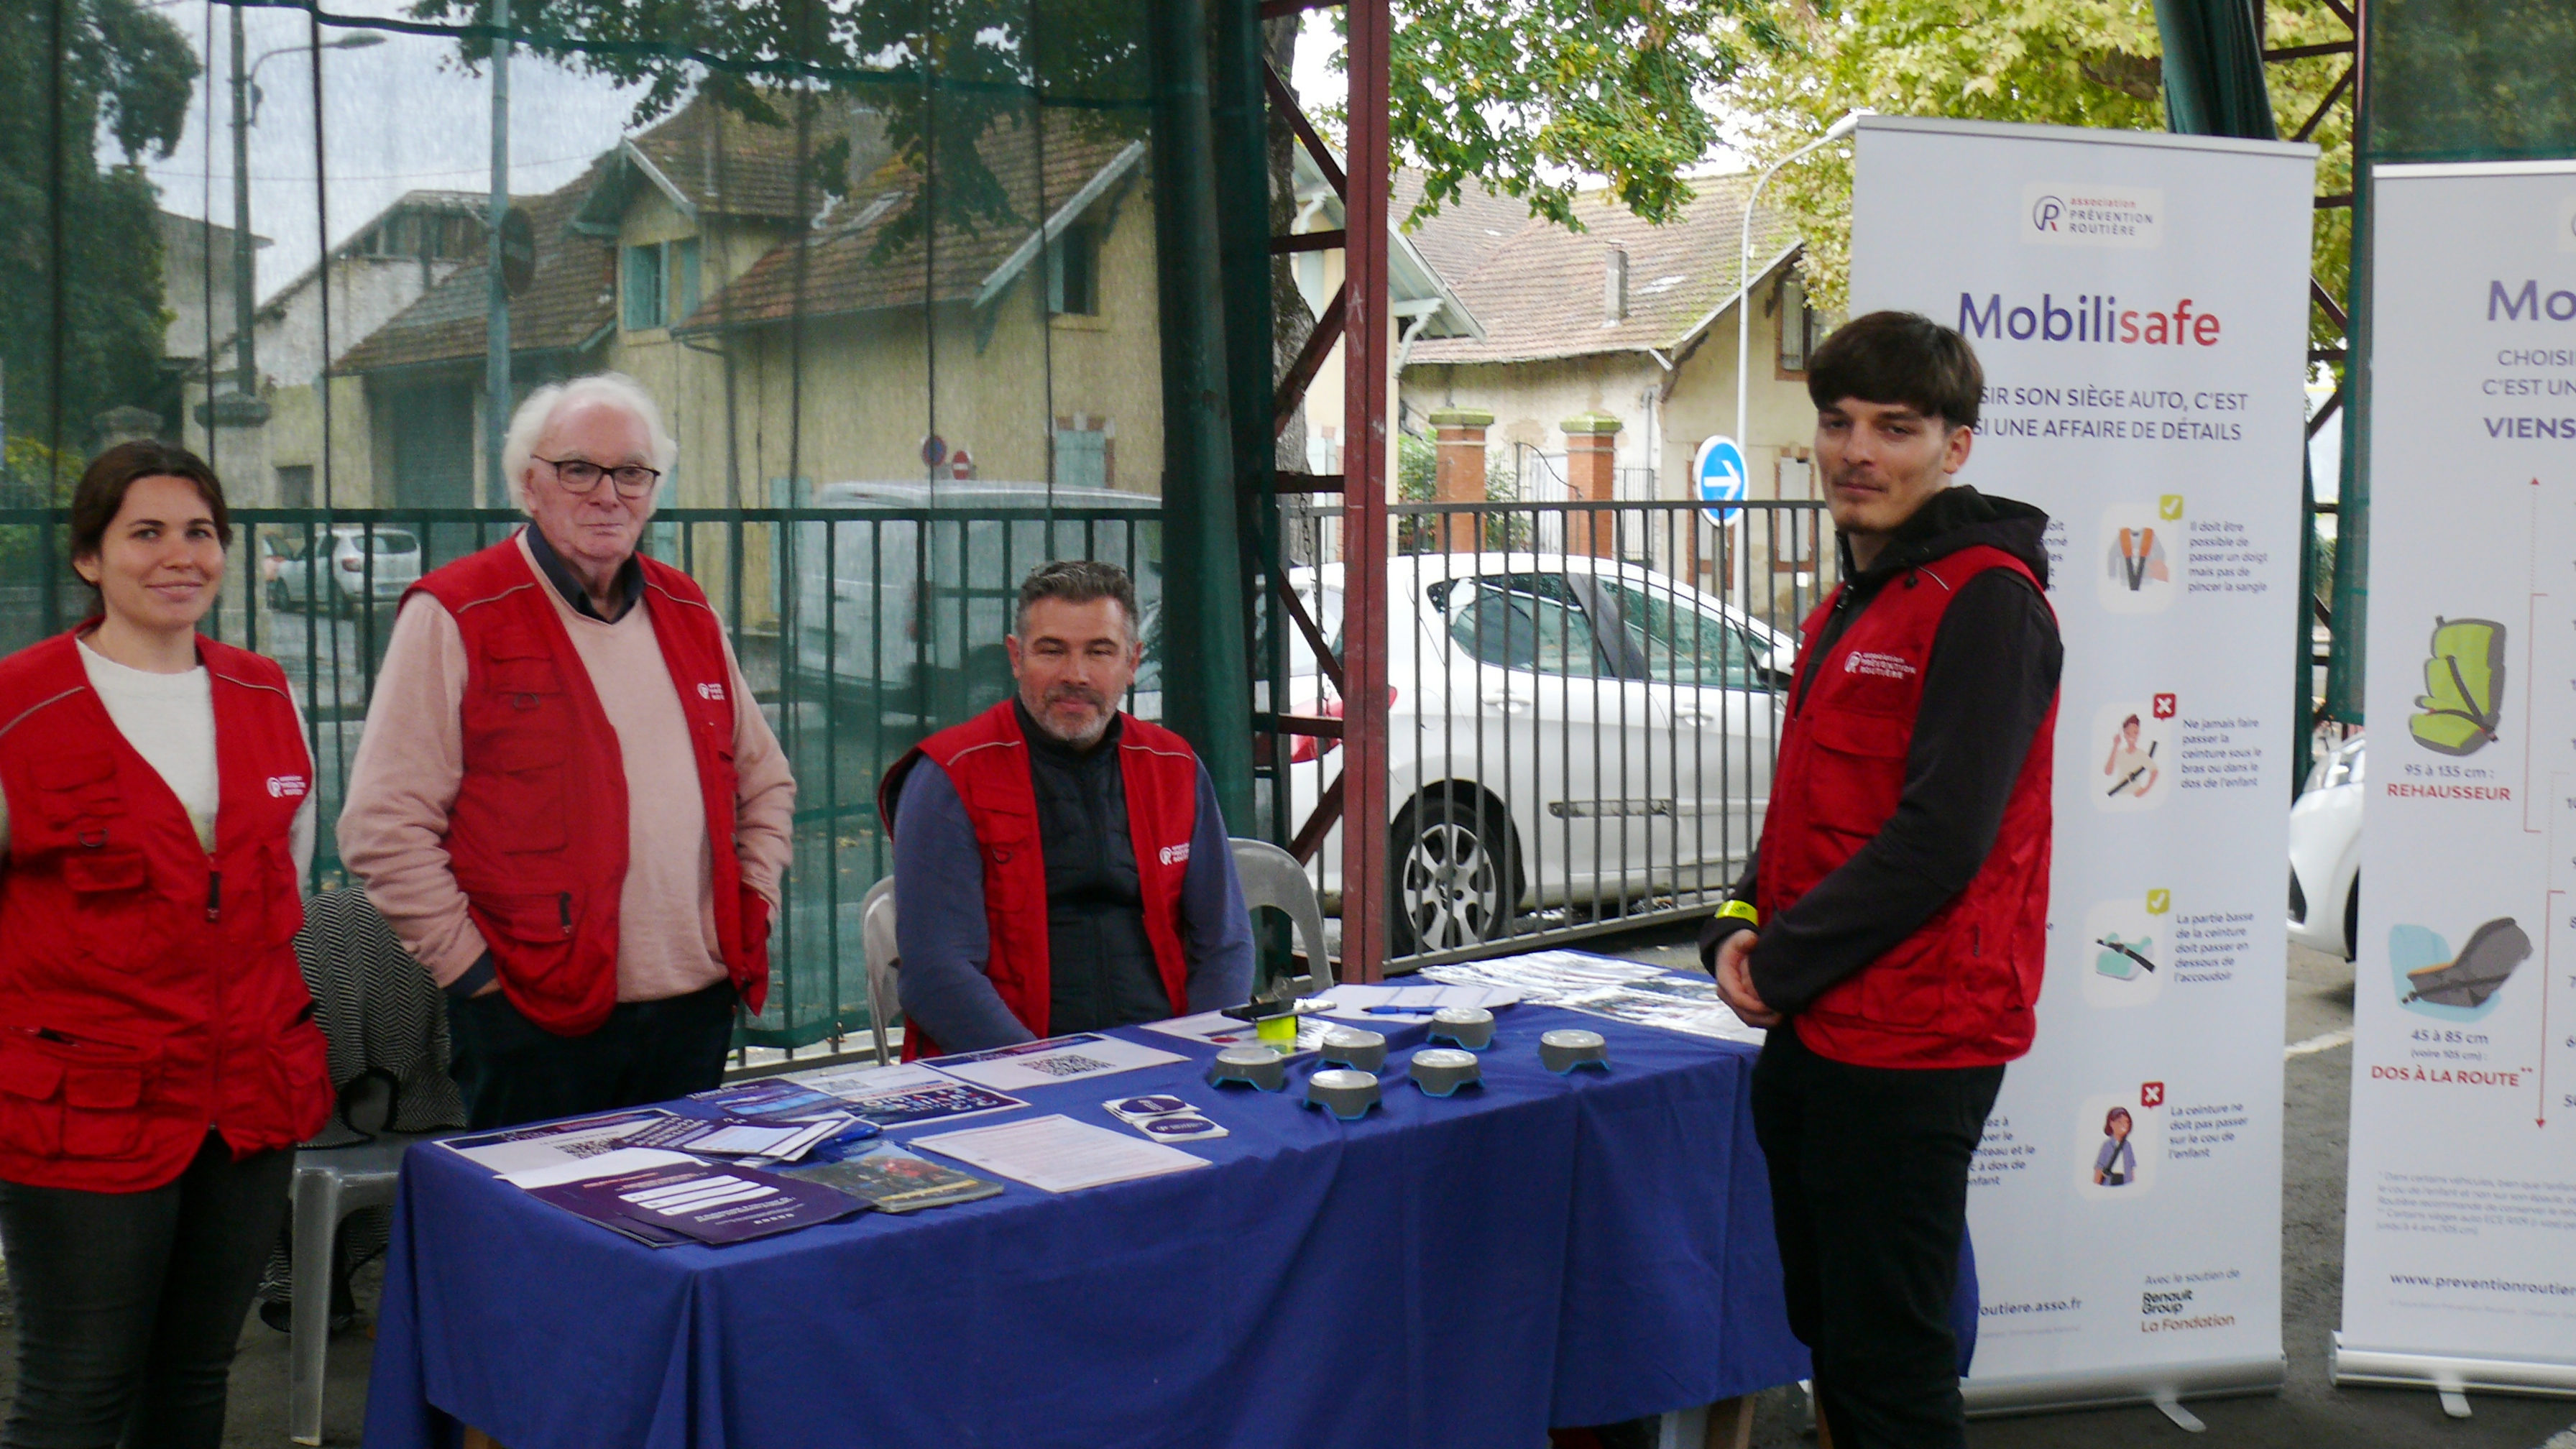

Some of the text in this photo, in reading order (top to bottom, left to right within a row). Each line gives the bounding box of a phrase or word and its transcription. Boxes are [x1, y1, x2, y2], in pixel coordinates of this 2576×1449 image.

[2069, 208, 2153, 224] PRÉVENTION
[2069, 222, 2136, 236] ROUTIÈRE
[2488, 280, 2576, 321] Mo
[1959, 292, 2221, 346] Mobilisafe
[2498, 349, 2576, 367] CHOISI
[2483, 378, 2542, 396] C'EST
[1979, 383, 2248, 413] SIR SON SIÈGE AUTO, C'EST
[1972, 417, 2242, 441] SI UNE AFFAIRE DE DÉTAILS
[2483, 417, 2576, 439] VIENS
[2199, 521, 2221, 532] doit
[2189, 537, 2250, 548] possible de
[2189, 553, 2224, 564] passer
[2227, 553, 2240, 562] un
[2237, 568, 2250, 577] de
[2183, 718, 2199, 729] Ne
[2182, 733, 2230, 746] passer la
[2181, 762, 2206, 774] bras
[2207, 765, 2221, 773] ou
[2404, 763, 2422, 777] 95
[2424, 764, 2434, 778] à
[2464, 767, 2487, 779] cm
[2203, 778, 2218, 788] de
[2386, 782, 2511, 801] REHAUSSEUR
[2176, 911, 2255, 926] La partie basse
[2176, 928, 2191, 939] de
[2192, 927, 2203, 939] la
[2175, 943, 2197, 954] doit
[2221, 956, 2235, 967] de
[2466, 1033, 2489, 1045] cm
[2371, 1064, 2409, 1081] DOS
[2413, 1064, 2427, 1082] À
[2430, 1069, 2453, 1084] LA
[2169, 1105, 2184, 1116] La
[1972, 1147, 2008, 1157] nteau
[1969, 1175, 2000, 1187] nfant
[2143, 1289, 2193, 1303] Renault
[1979, 1295, 2082, 1317] outiere.asso.fr
[2142, 1302, 2184, 1316] Group
[2141, 1314, 2235, 1333] La Fondation
